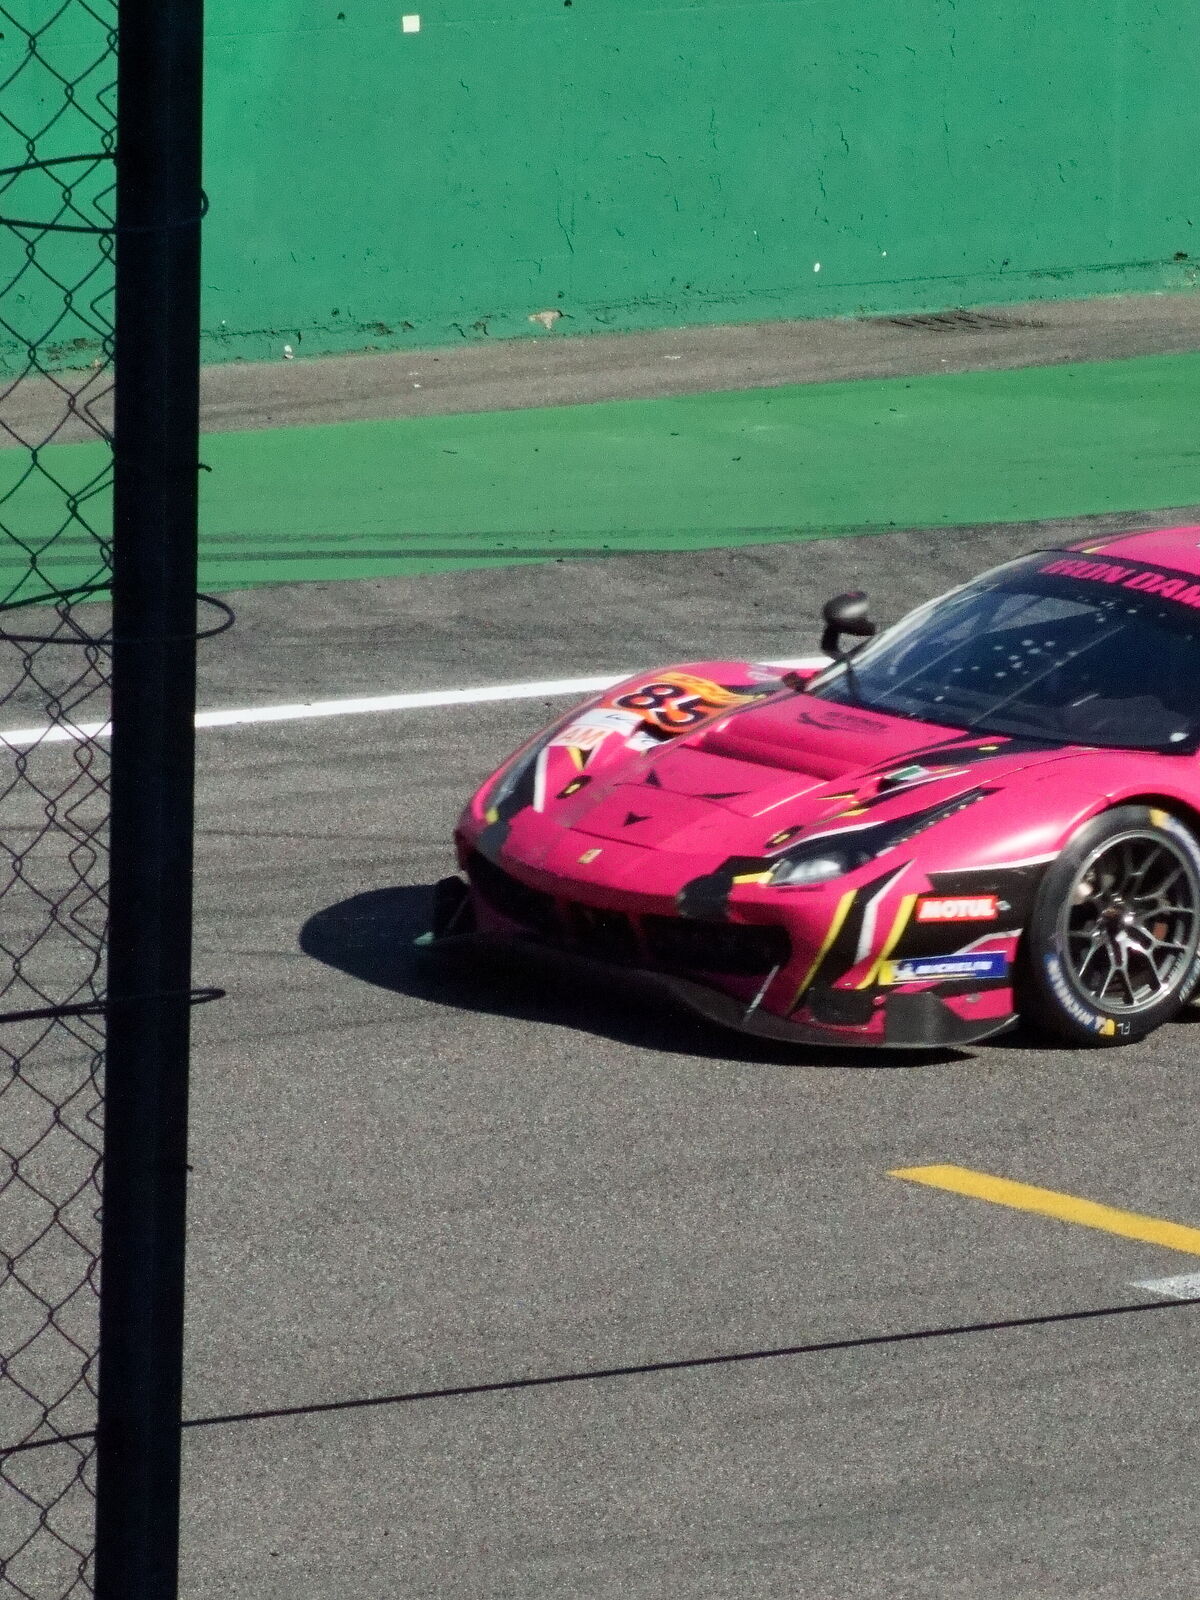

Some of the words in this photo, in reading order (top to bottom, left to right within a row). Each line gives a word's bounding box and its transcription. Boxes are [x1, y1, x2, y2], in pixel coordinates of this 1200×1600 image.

[1039, 559, 1138, 584] IRON
[612, 682, 709, 730] 85
[917, 898, 995, 919] MOTUL
